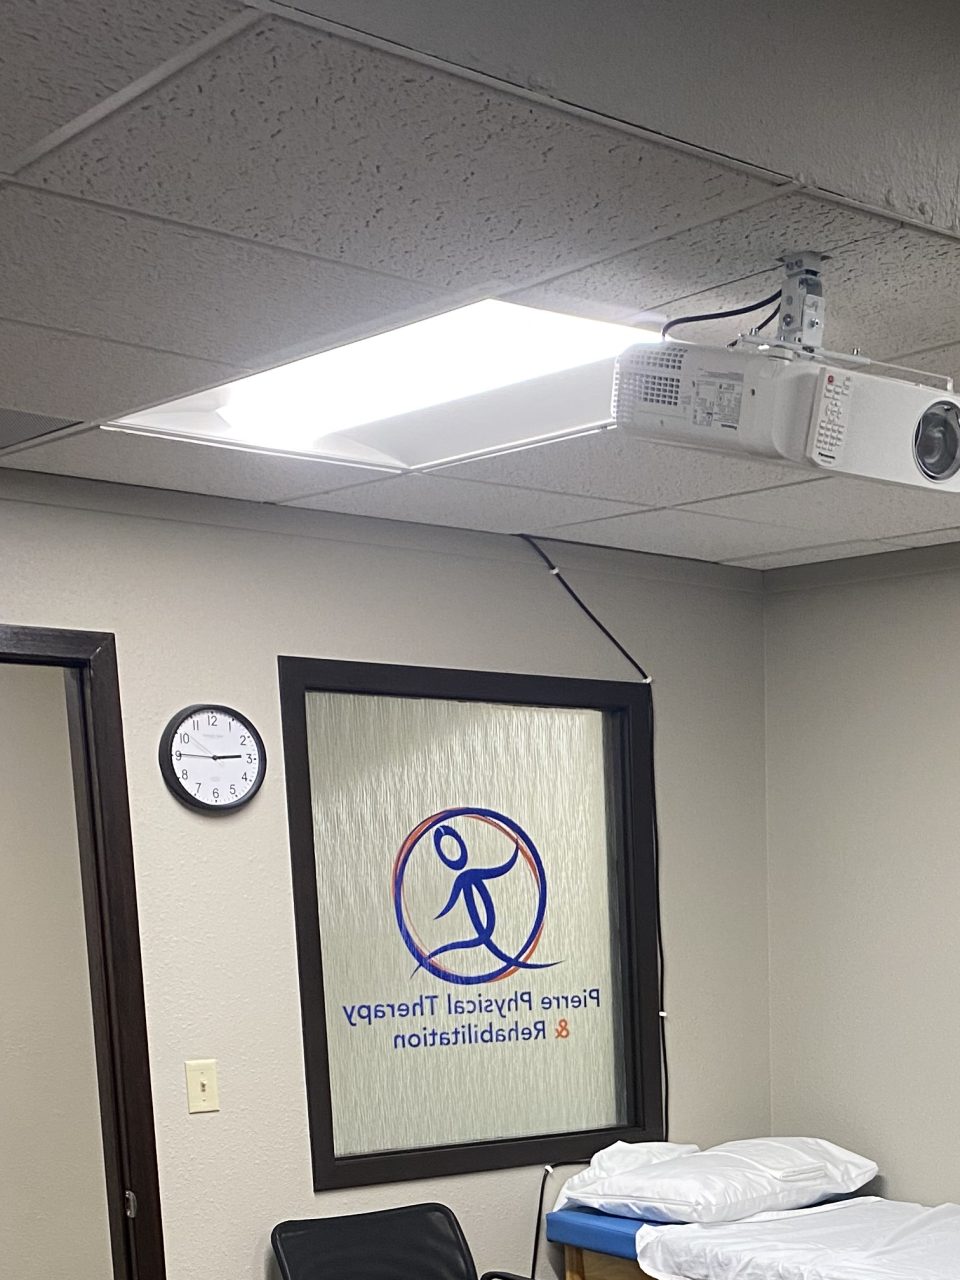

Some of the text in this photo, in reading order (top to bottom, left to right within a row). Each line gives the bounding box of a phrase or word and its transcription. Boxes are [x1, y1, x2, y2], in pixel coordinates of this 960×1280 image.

[192, 719, 199, 731] 11
[208, 714, 218, 726] 12
[180, 732, 190, 744] 10
[240, 735, 247, 746] 2
[174, 750, 182, 761] 9
[246, 753, 253, 764] 3
[181, 769, 189, 780] 8
[241, 772, 248, 781] 4
[195, 782, 202, 793] 7
[212, 787, 220, 798] 6
[229, 784, 236, 795] 5
